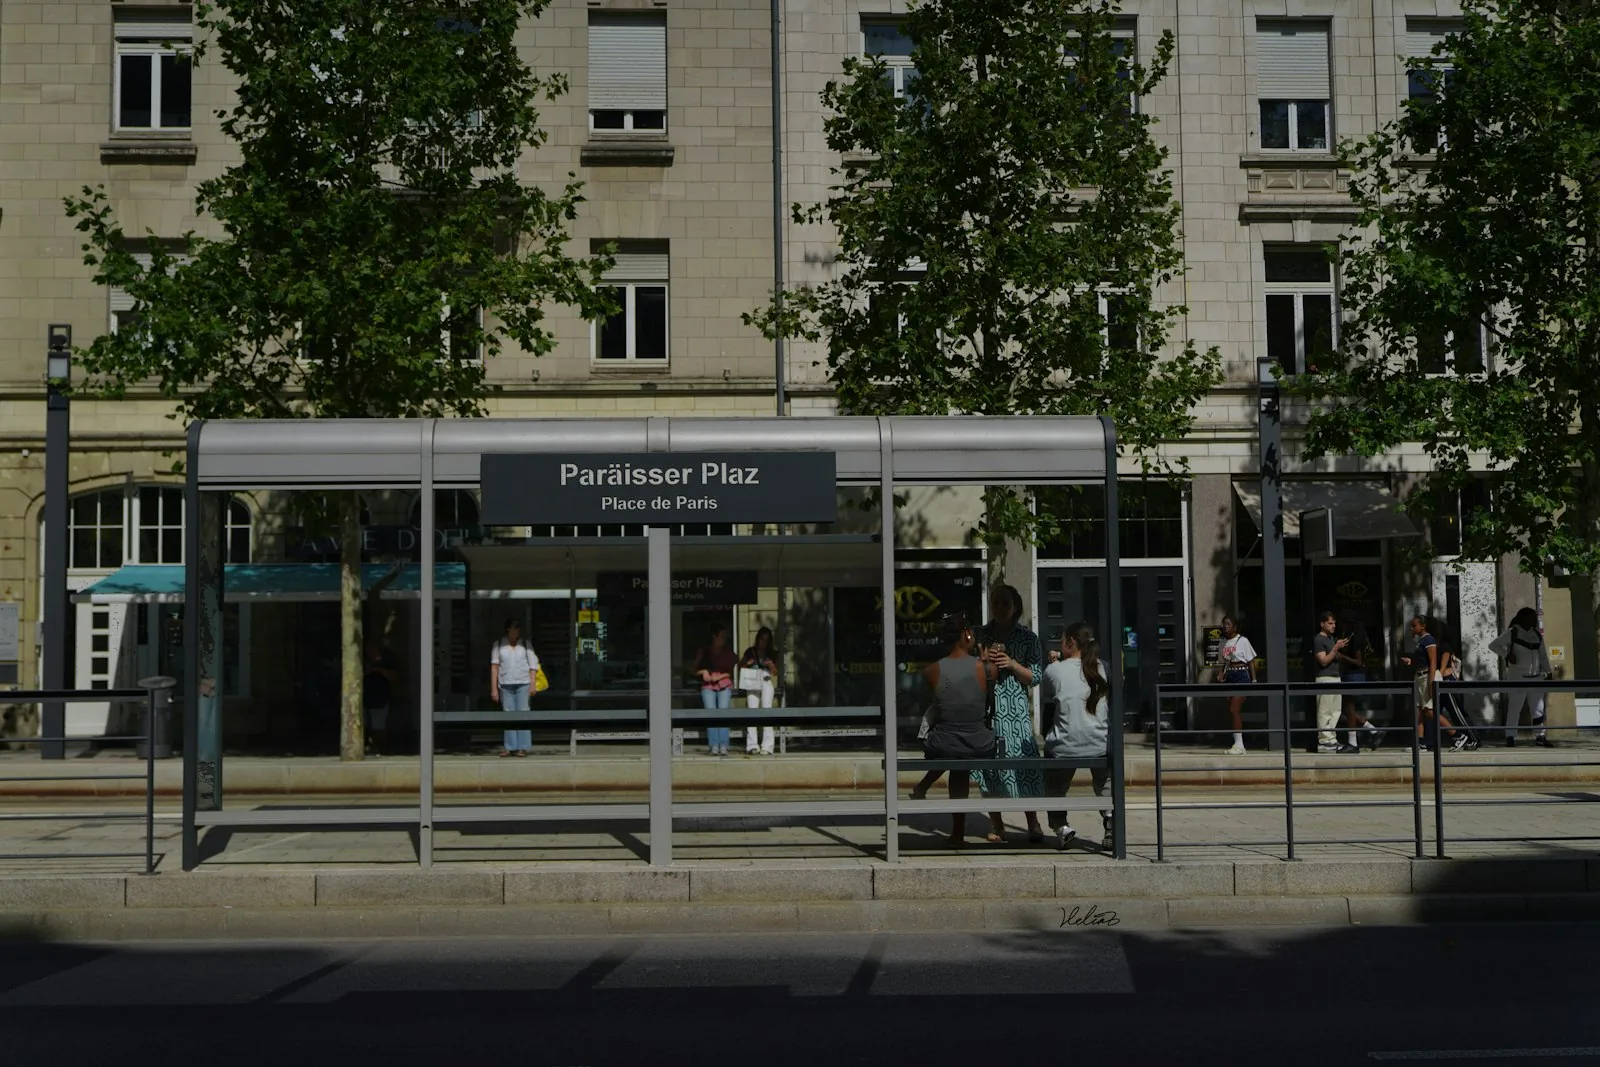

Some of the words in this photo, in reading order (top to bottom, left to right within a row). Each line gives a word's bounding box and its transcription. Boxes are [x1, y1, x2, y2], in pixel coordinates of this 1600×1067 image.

[560, 463, 693, 486] Paräisser
[701, 462, 760, 485] Plaz
[601, 496, 647, 510] Place
[650, 495, 671, 511] de
[676, 495, 718, 511] Paris
[632, 577, 694, 589] Paser
[696, 576, 723, 589] Plaz
[672, 592, 683, 600] de
[684, 592, 704, 600] Paris
[925, 636, 939, 646] eat
